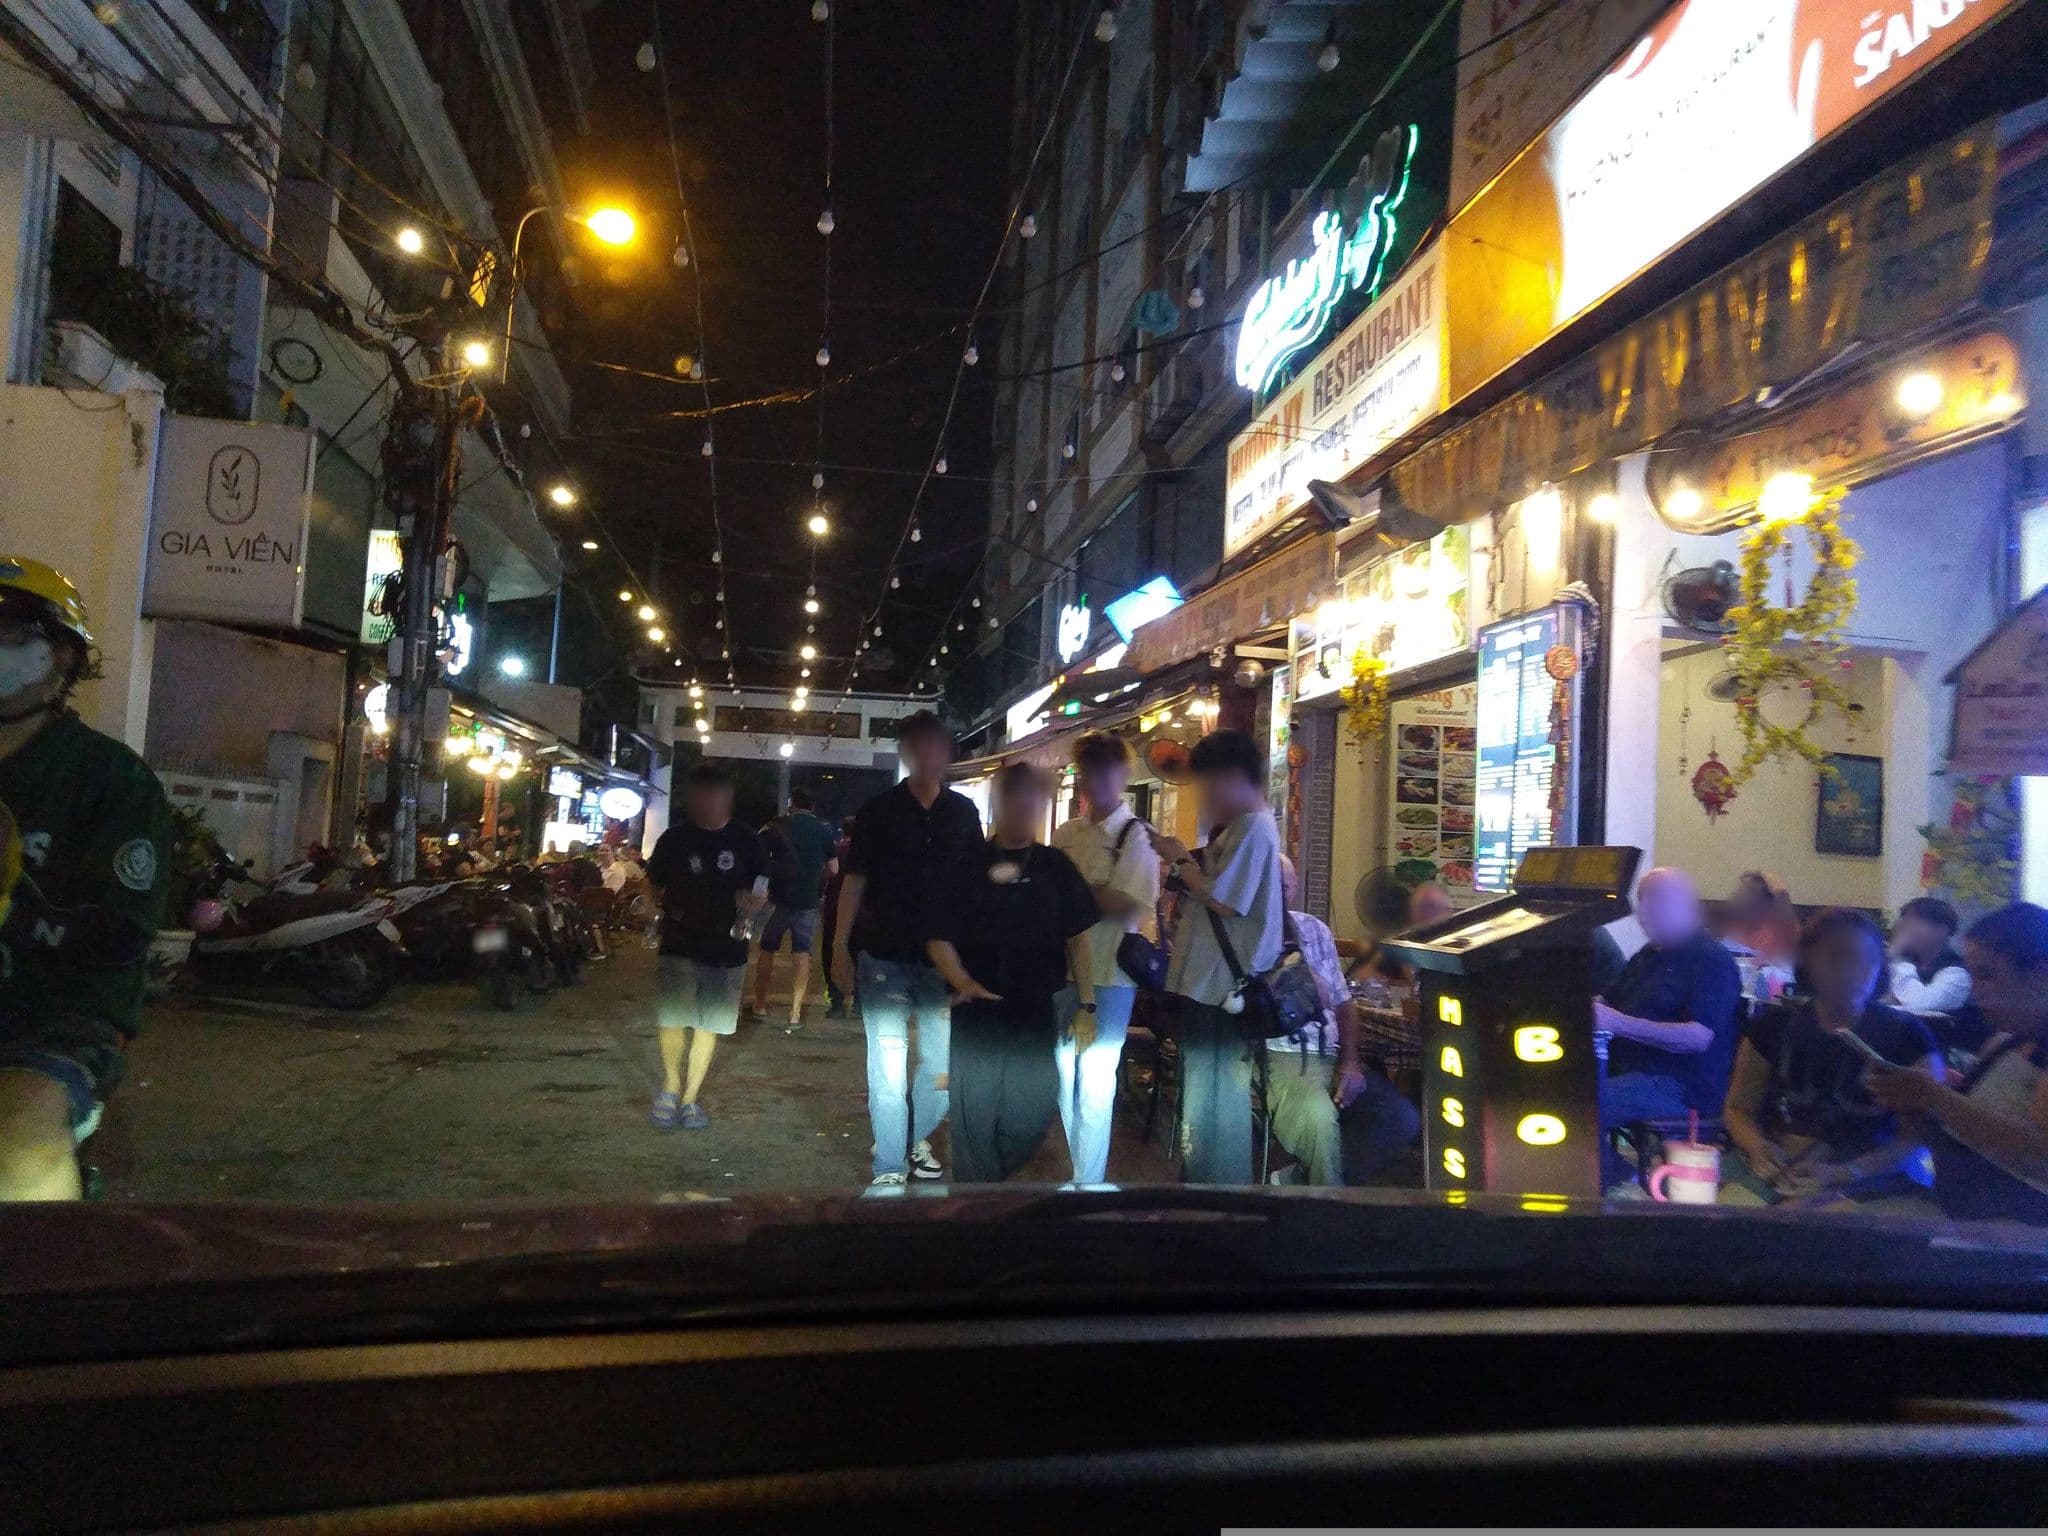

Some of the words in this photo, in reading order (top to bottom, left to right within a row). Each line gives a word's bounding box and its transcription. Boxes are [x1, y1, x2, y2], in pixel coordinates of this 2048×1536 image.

[1312, 262, 1435, 419] RESTAURANT
[160, 531, 211, 557] GIA
[224, 531, 293, 564] VIÊN
[1514, 1026, 1569, 1200] BO
